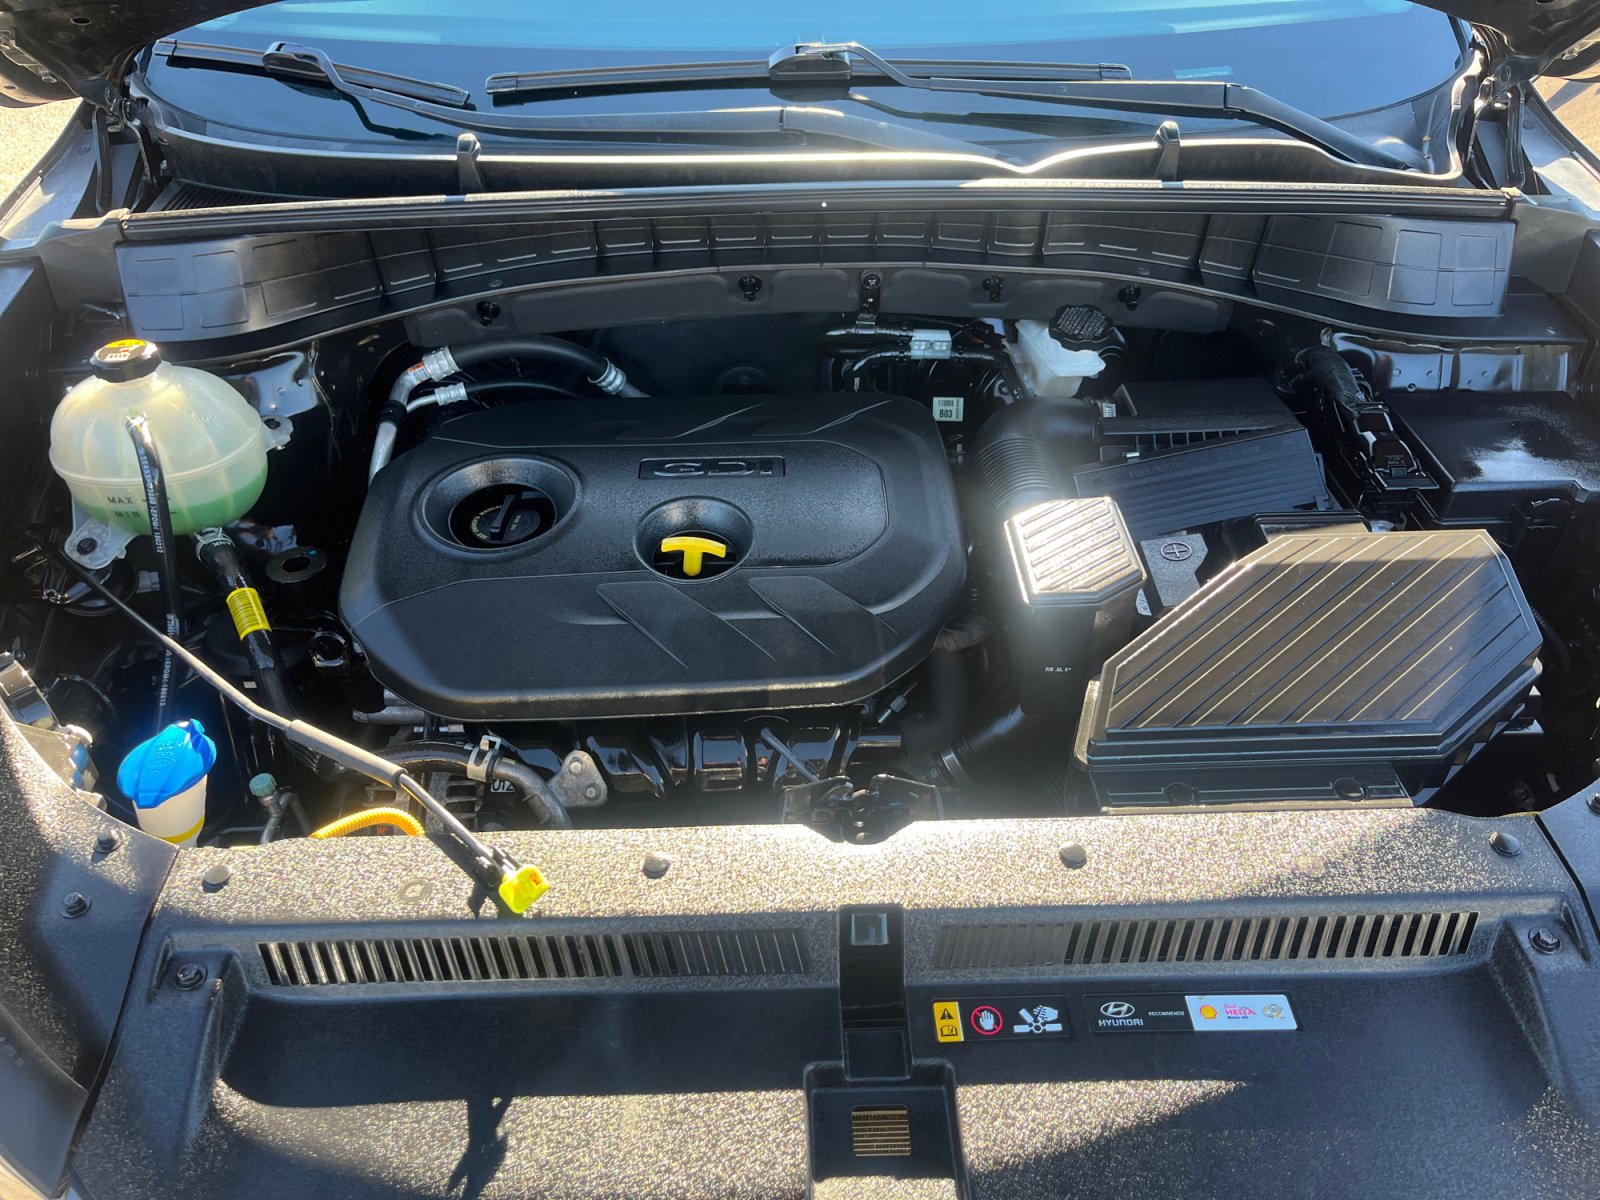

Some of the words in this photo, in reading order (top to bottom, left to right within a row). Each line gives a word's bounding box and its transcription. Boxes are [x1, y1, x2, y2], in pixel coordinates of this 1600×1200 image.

[940, 409, 952, 418] B03
[107, 496, 133, 504] MAX
[1098, 1018, 1144, 1027] HYUNDAI
